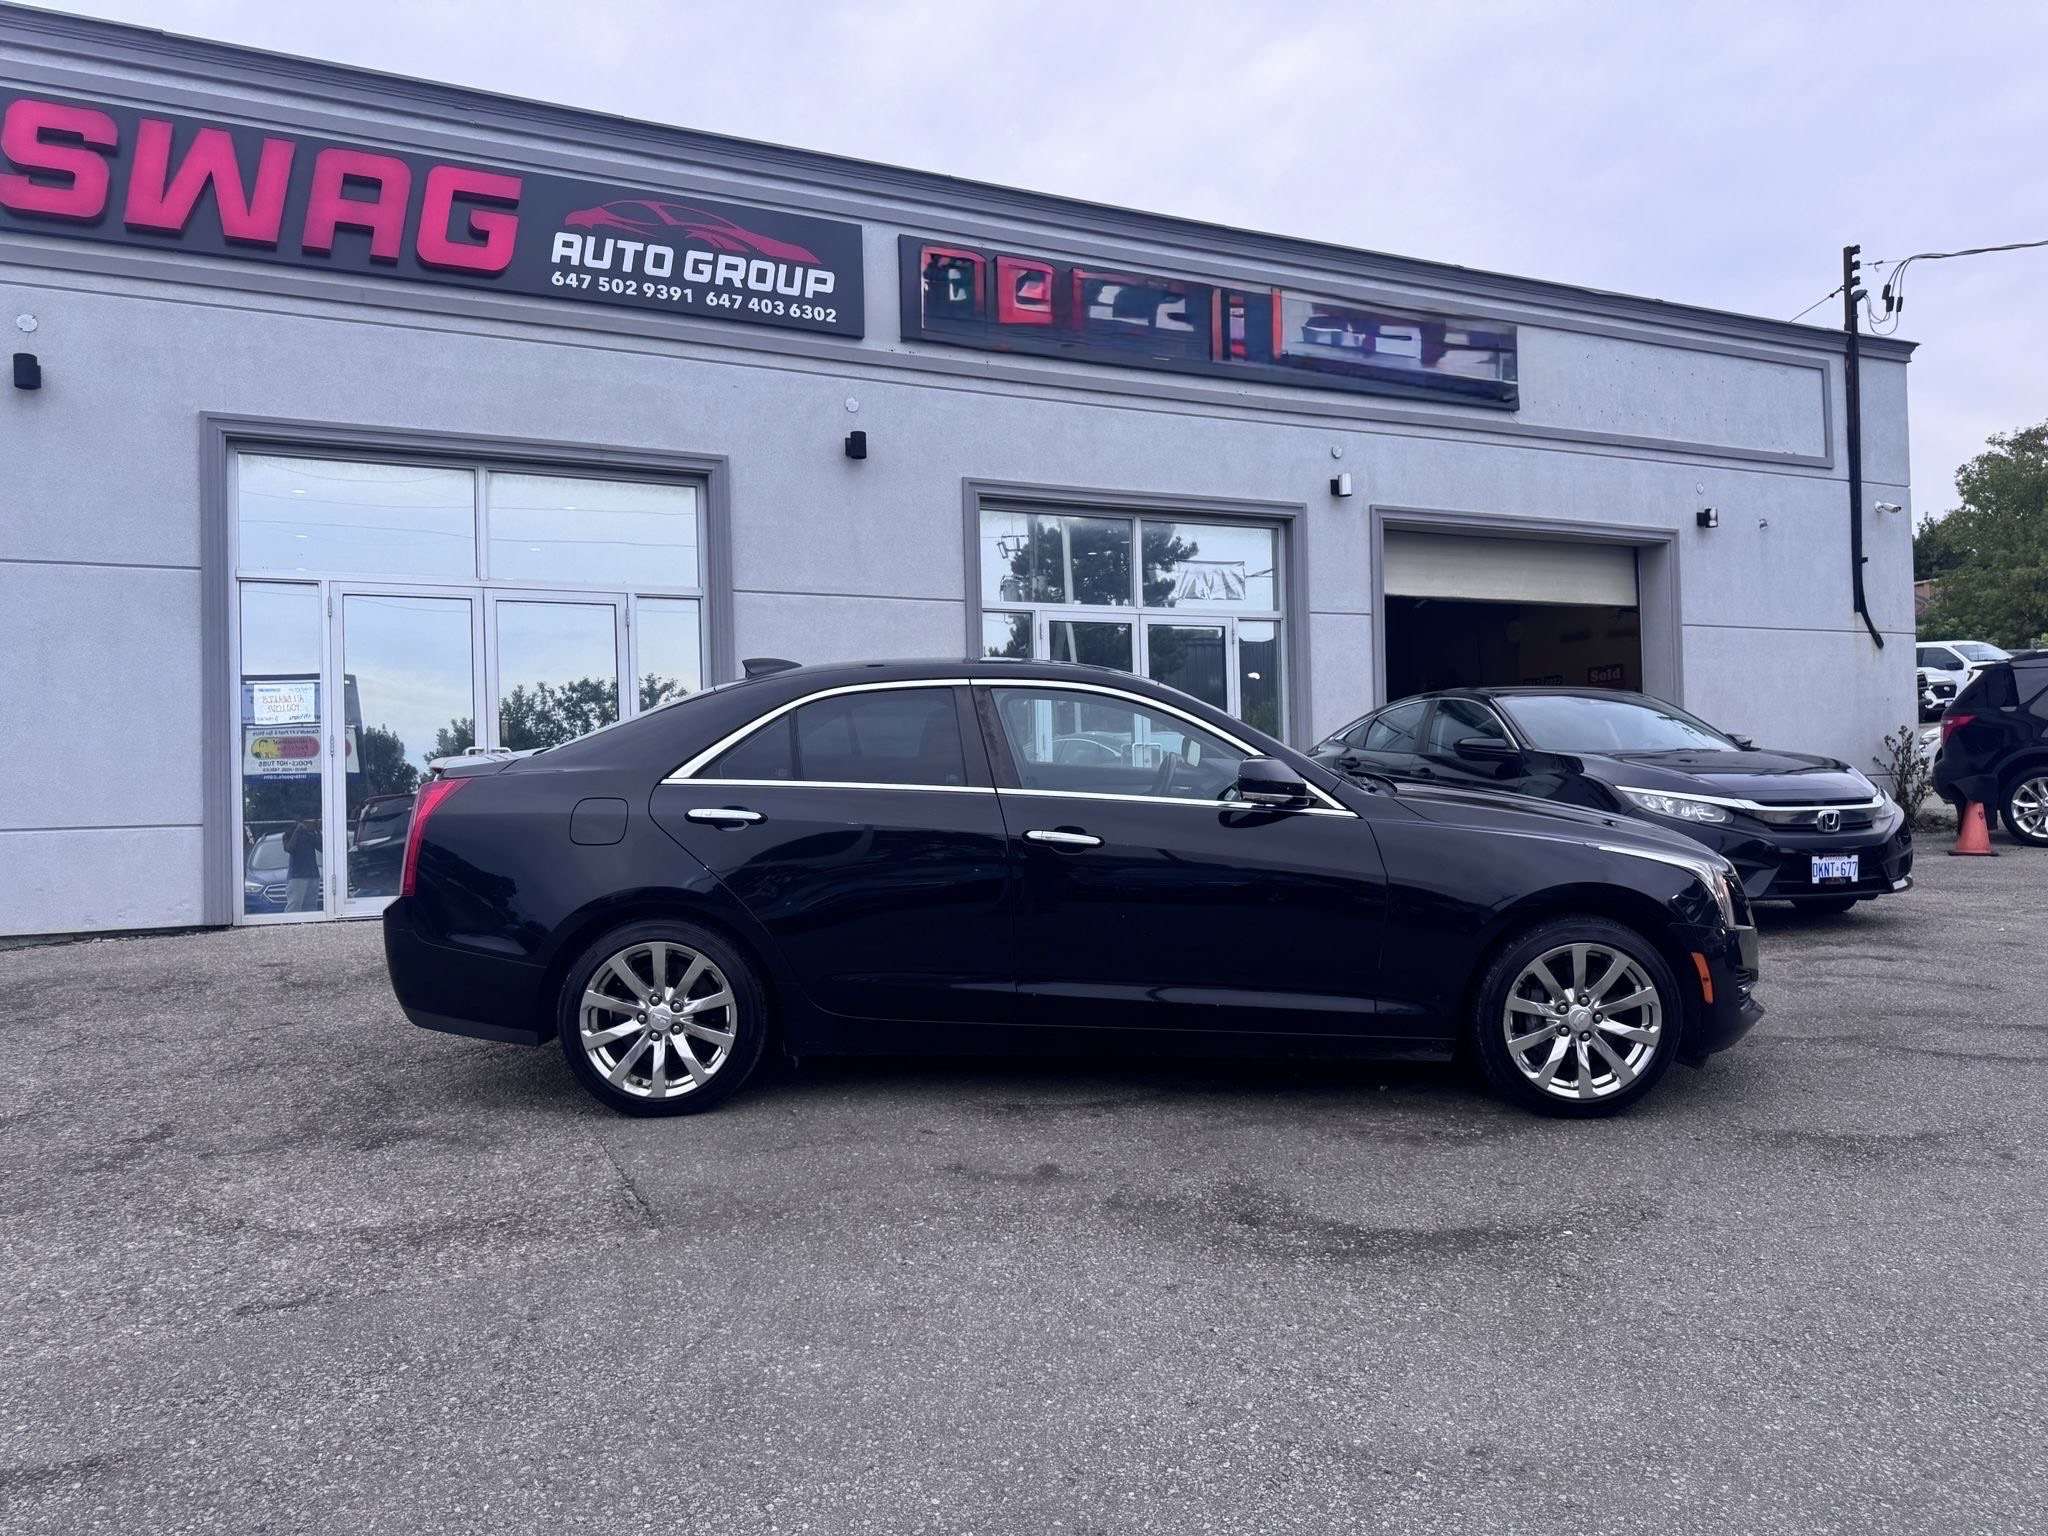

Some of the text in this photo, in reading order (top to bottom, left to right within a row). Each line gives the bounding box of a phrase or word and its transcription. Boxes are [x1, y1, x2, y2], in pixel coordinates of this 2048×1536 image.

[0, 99, 523, 272] SWAG
[551, 231, 835, 298] AUTO GROUP
[551, 271, 837, 323] 647 502 9391 647 403 6302
[1590, 668, 1621, 682] Sold
